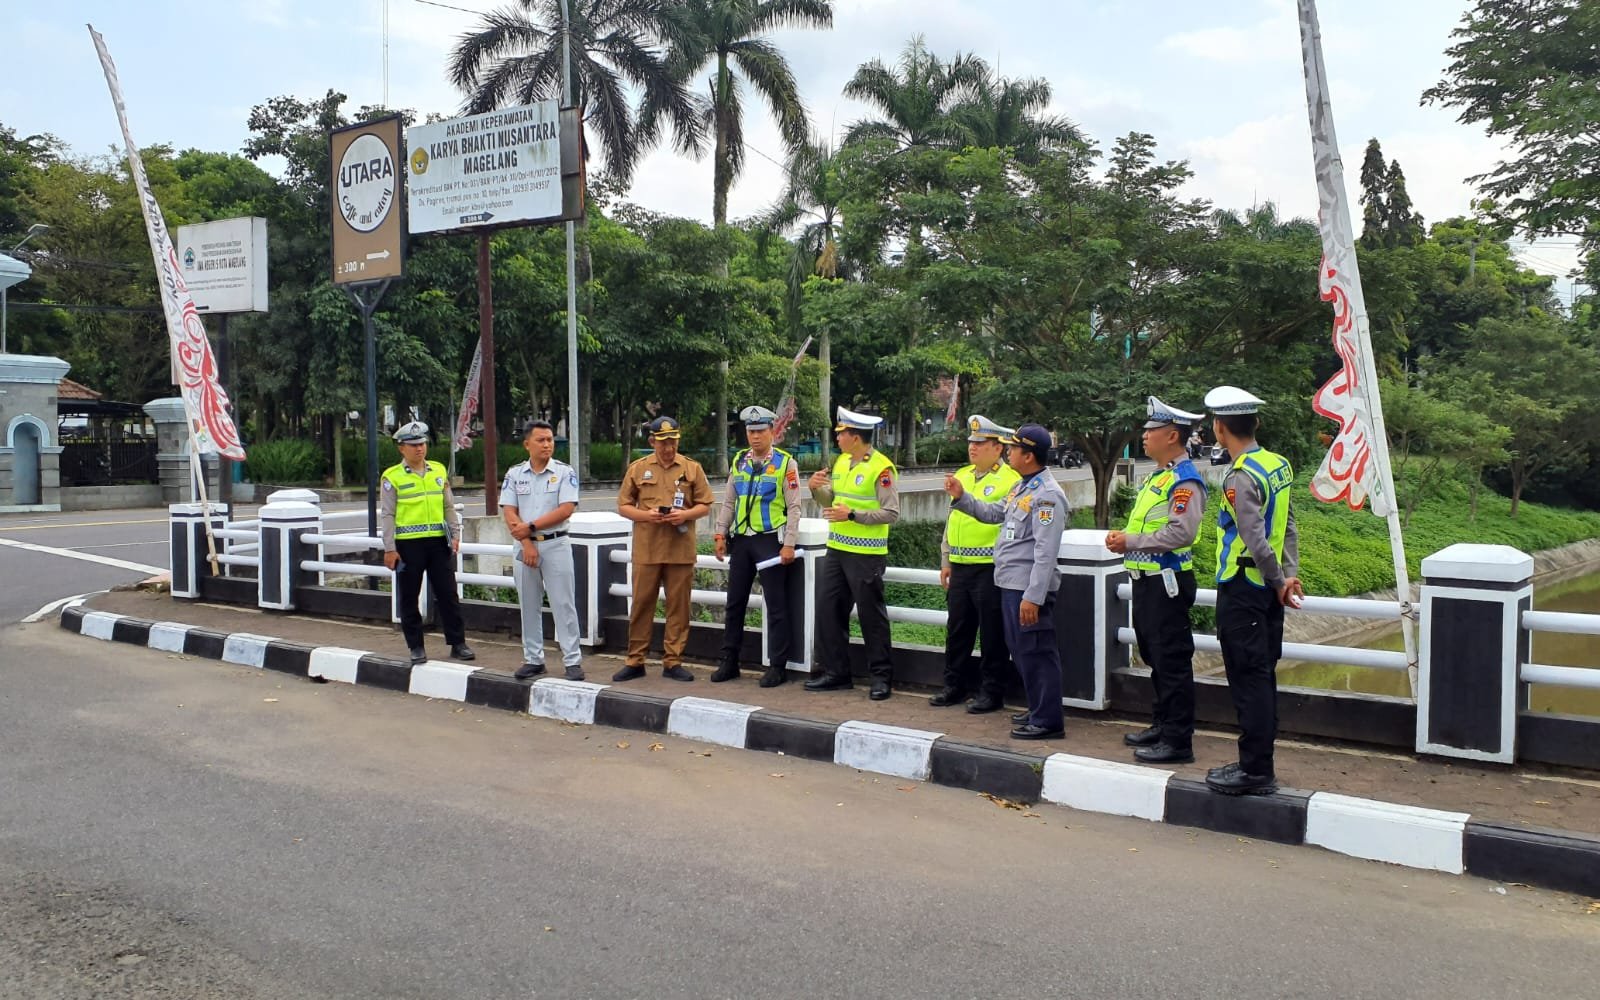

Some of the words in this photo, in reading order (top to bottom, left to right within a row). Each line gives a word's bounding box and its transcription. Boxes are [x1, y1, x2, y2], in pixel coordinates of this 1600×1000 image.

[447, 119, 479, 137] AKADEMI
[481, 109, 533, 130] KEPERAWATAN
[430, 139, 459, 160] KARYA
[461, 132, 496, 155] BHAKTI
[498, 121, 557, 147] NUSANTARA
[341, 156, 392, 187] UTARA
[464, 149, 518, 175] MAGELANG
[344, 261, 357, 273] 300
